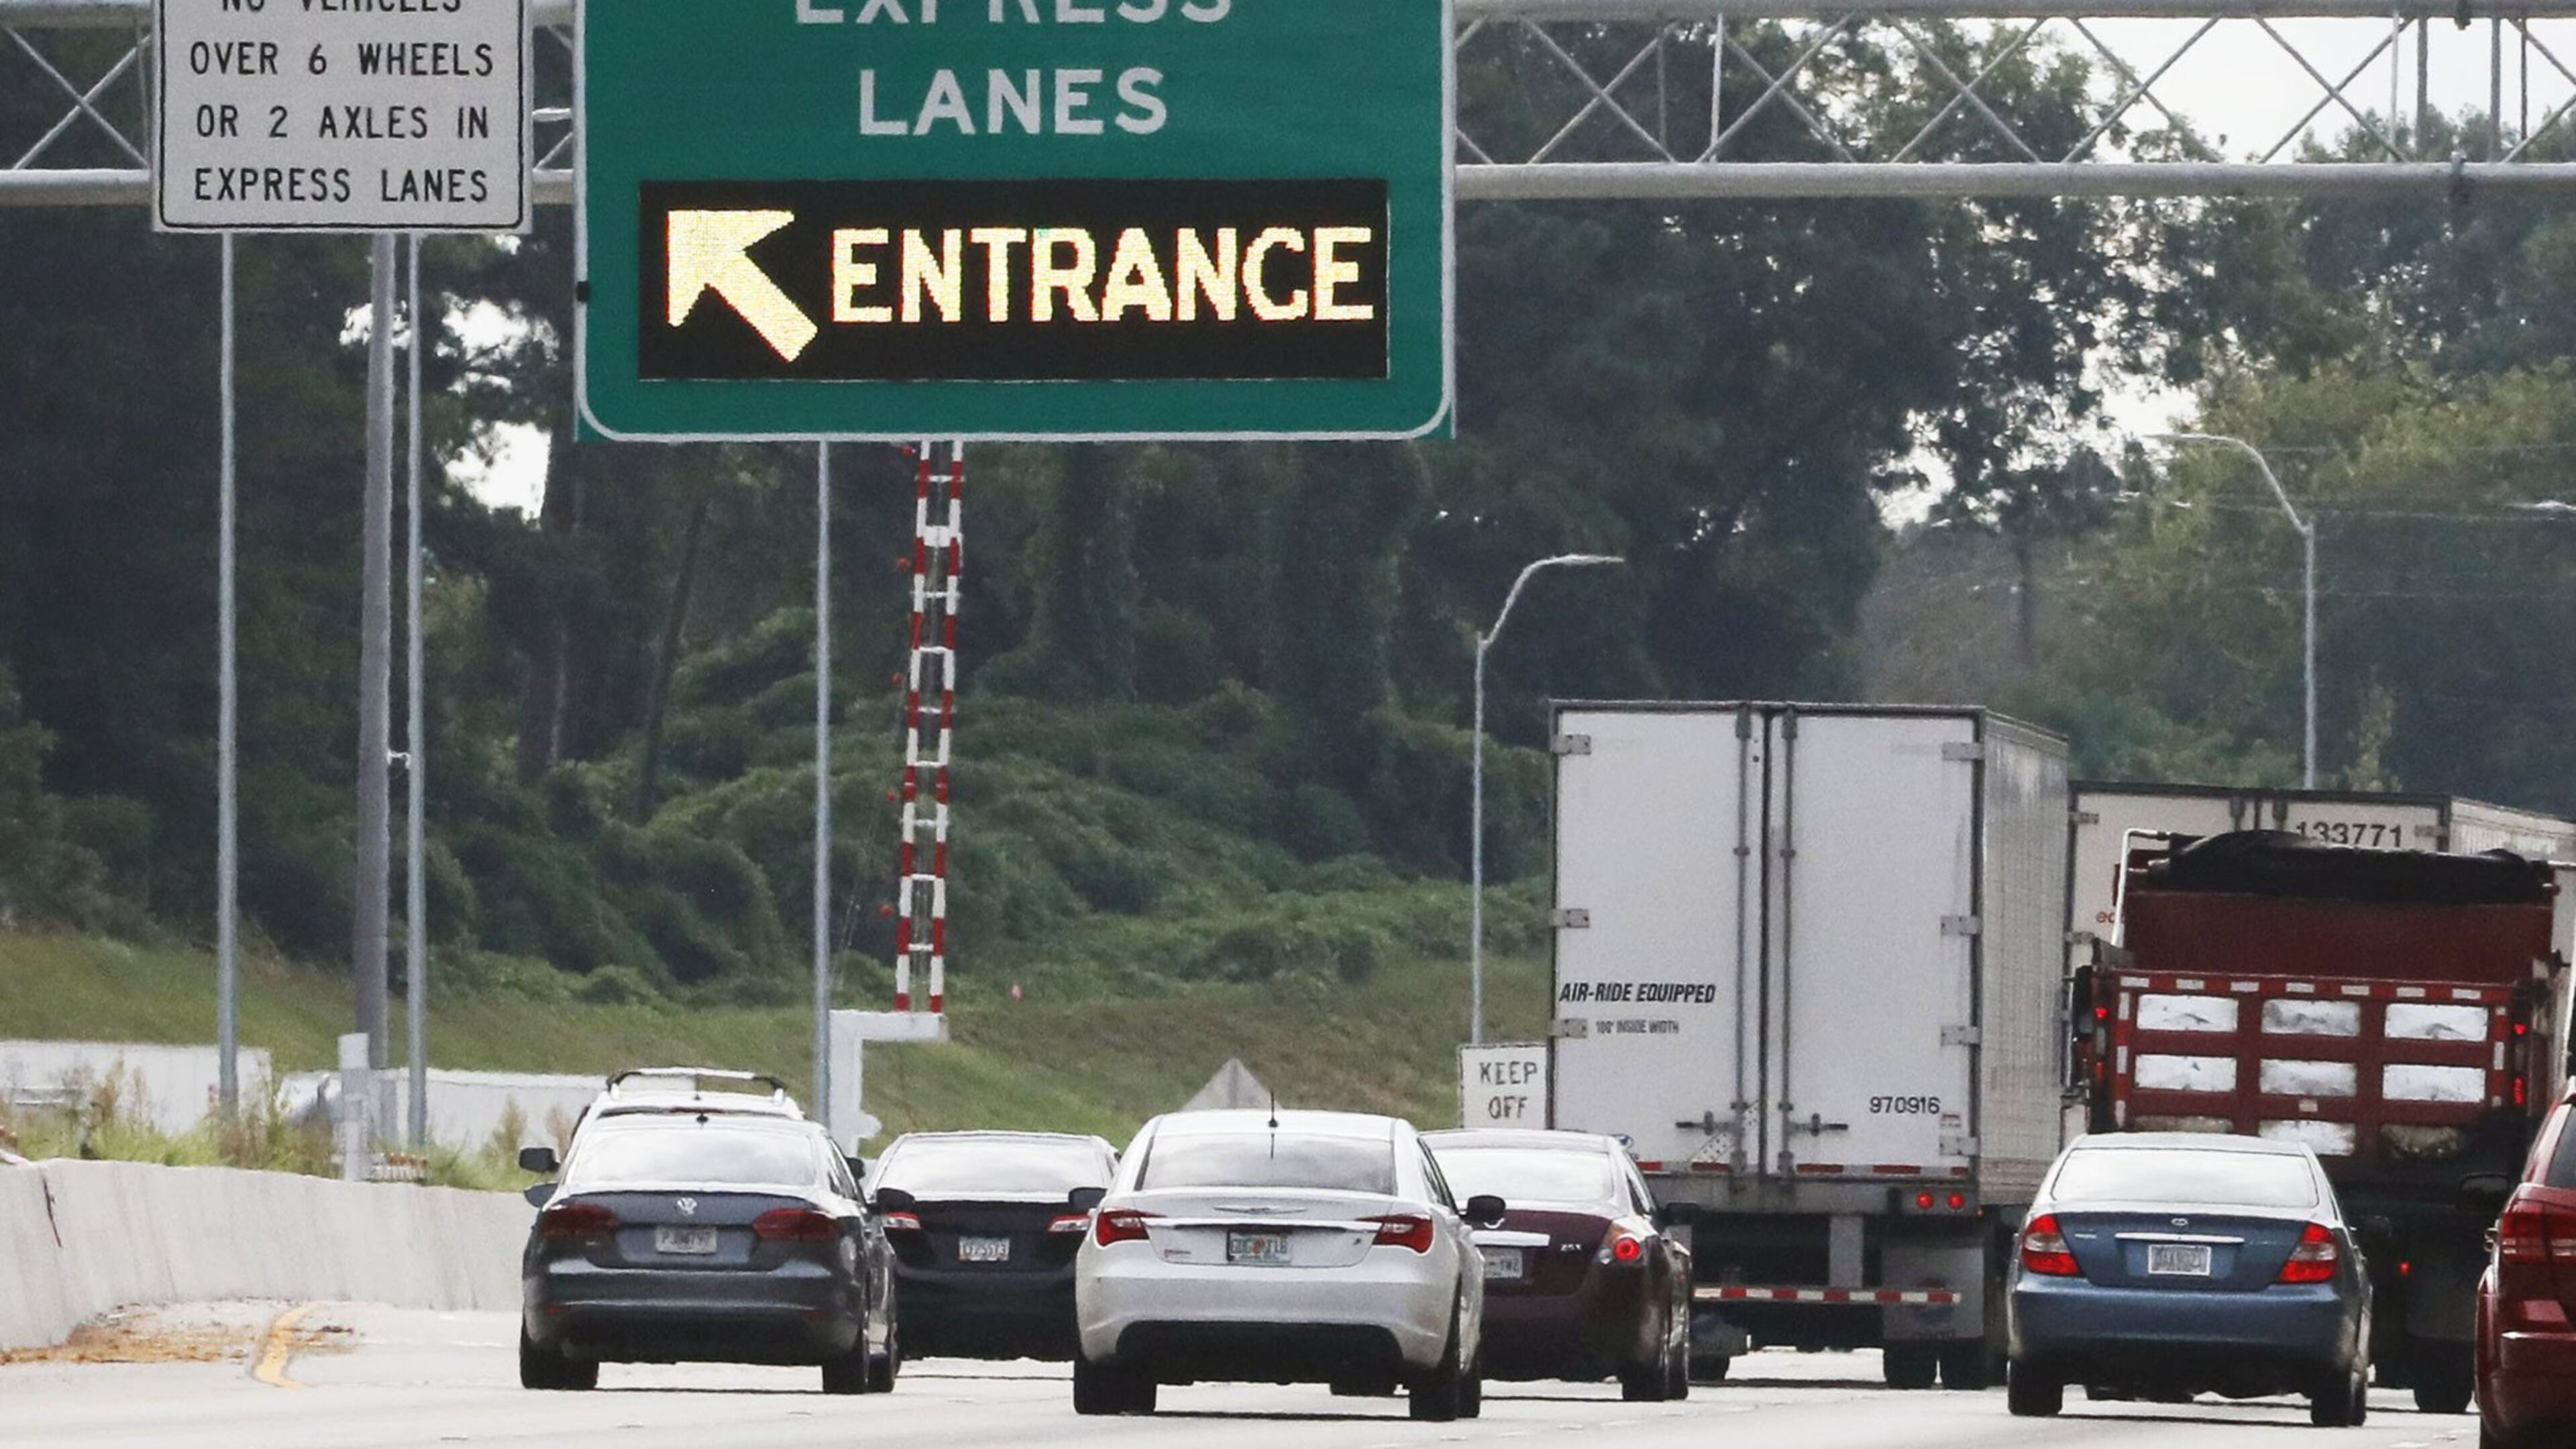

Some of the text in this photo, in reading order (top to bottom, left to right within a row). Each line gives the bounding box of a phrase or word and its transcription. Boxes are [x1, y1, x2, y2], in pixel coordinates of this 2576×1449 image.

[191, 42, 494, 76] OVER 6 WHEELS
[859, 67, 1168, 136] LANES
[197, 105, 488, 138] OR 2 AXLES IN
[195, 168, 488, 203] EXPRESS LANES
[833, 227, 1374, 323] ENTRANCE
[2296, 821, 2402, 848] 133771
[1559, 982, 1717, 1004] AIR-RIDE EQUIPPED
[1616, 1020, 1647, 1034] INSIDE
[1648, 1020, 1680, 1034] WIDTH
[1479, 1061, 1538, 1085] KEEP
[1488, 1095, 1527, 1120] OFF
[1870, 1096, 1941, 1114] 970916
